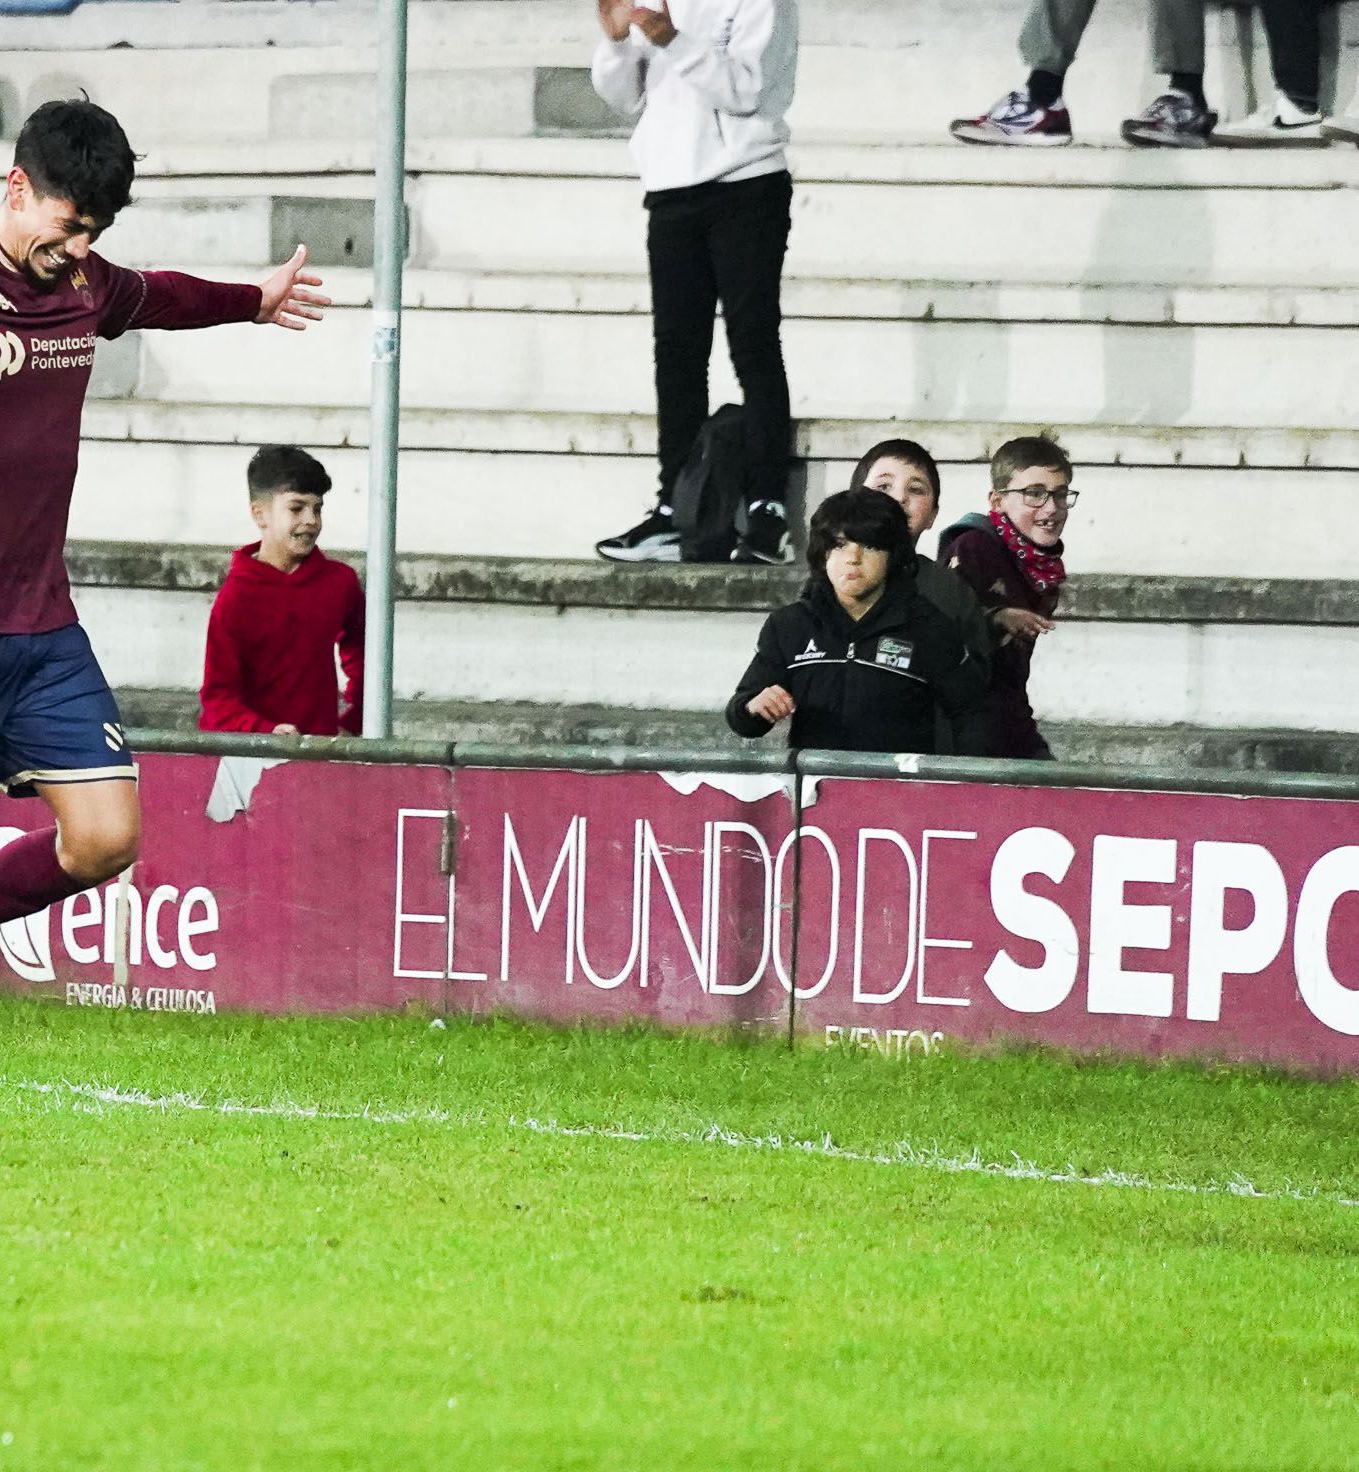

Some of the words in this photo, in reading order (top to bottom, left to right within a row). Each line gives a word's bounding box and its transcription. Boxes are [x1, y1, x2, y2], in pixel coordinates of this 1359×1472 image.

[61, 883, 219, 971] ence
[500, 811, 841, 1000] MUNDO
[852, 827, 978, 1007] DE
[131, 986, 143, 1010] &
